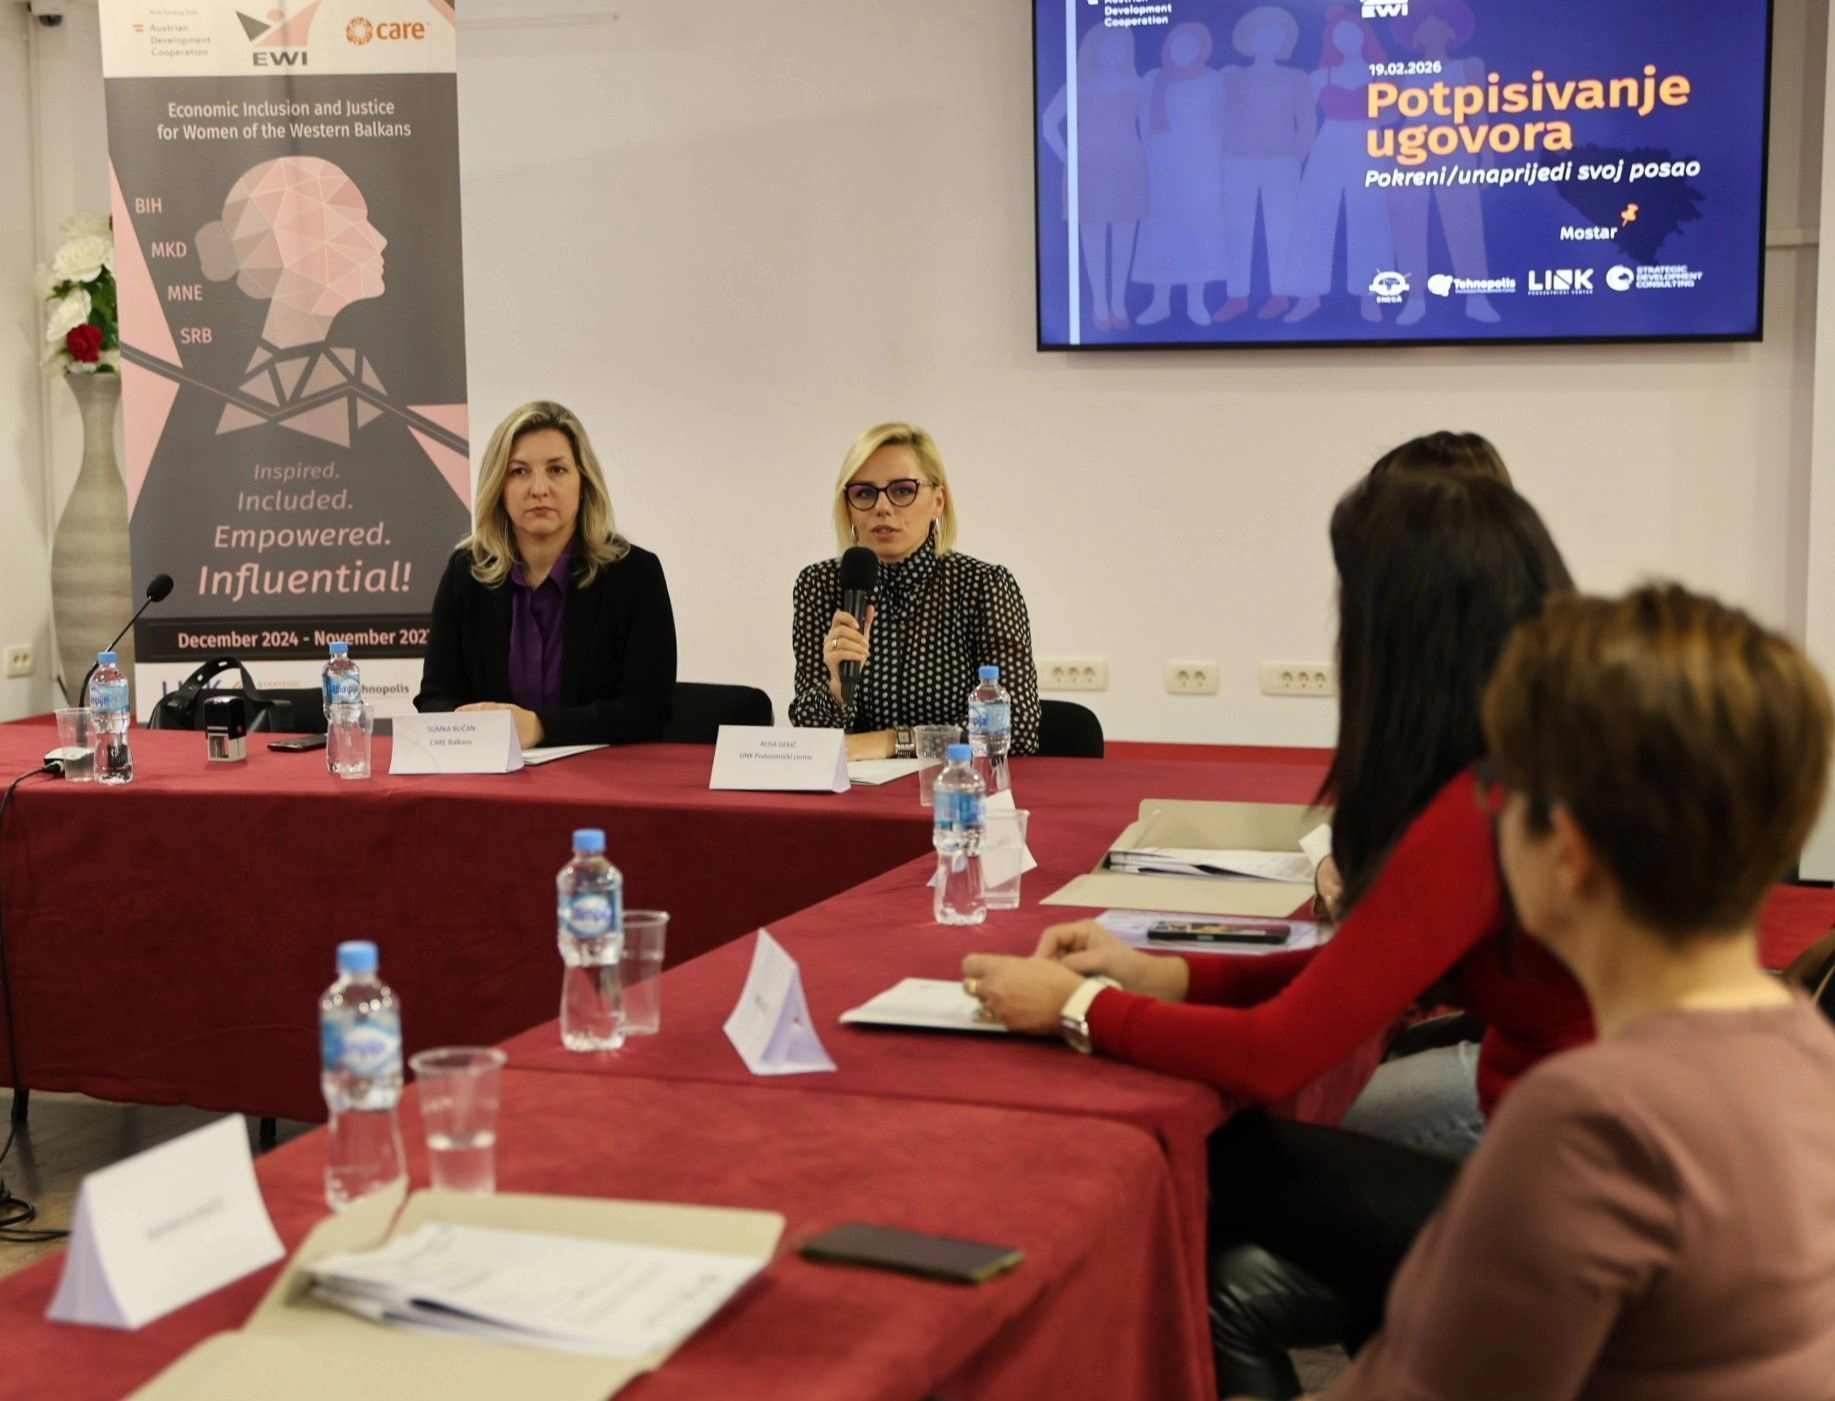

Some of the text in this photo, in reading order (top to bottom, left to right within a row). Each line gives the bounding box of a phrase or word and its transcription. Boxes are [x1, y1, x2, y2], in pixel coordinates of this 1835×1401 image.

[1104, 3, 1172, 16] Development
[151, 24, 189, 32] Austrian
[1104, 16, 1168, 27] Cooperation
[376, 21, 425, 40] care
[151, 36, 210, 46] Development
[151, 48, 208, 58] Cooperation
[252, 51, 308, 66] EWI
[1368, 61, 1442, 77] 19.02.2026
[1367, 64, 1691, 124] Potpisivanje
[168, 99, 395, 118] Economic Inclusion and Justice
[158, 121, 411, 140] for Women of the Western Balkans
[1366, 119, 1573, 166] ugovora
[1365, 159, 1701, 188] Pokreni/unaprijedi svoj posao
[135, 198, 162, 214] BIH
[1560, 225, 1618, 241] Mostar
[152, 242, 187, 258] MKD
[1636, 265, 1688, 274] STRATEGIC
[1636, 271, 1703, 281] DEVELOPMENT
[1453, 277, 1516, 291] Tehnopolis
[1528, 268, 1594, 290] LINK
[1635, 280, 1695, 289] CONSULTING
[167, 285, 203, 301] MNE
[180, 328, 212, 344] SRB
[254, 462, 340, 483] Inspired.
[238, 489, 354, 512] Included.
[214, 521, 392, 553] Empowered.
[198, 560, 413, 602] Influential!
[178, 631, 258, 649] December
[261, 631, 299, 647] 2024
[314, 629, 396, 647] November
[400, 629, 430, 645] 202
[361, 684, 410, 696] hnopolis
